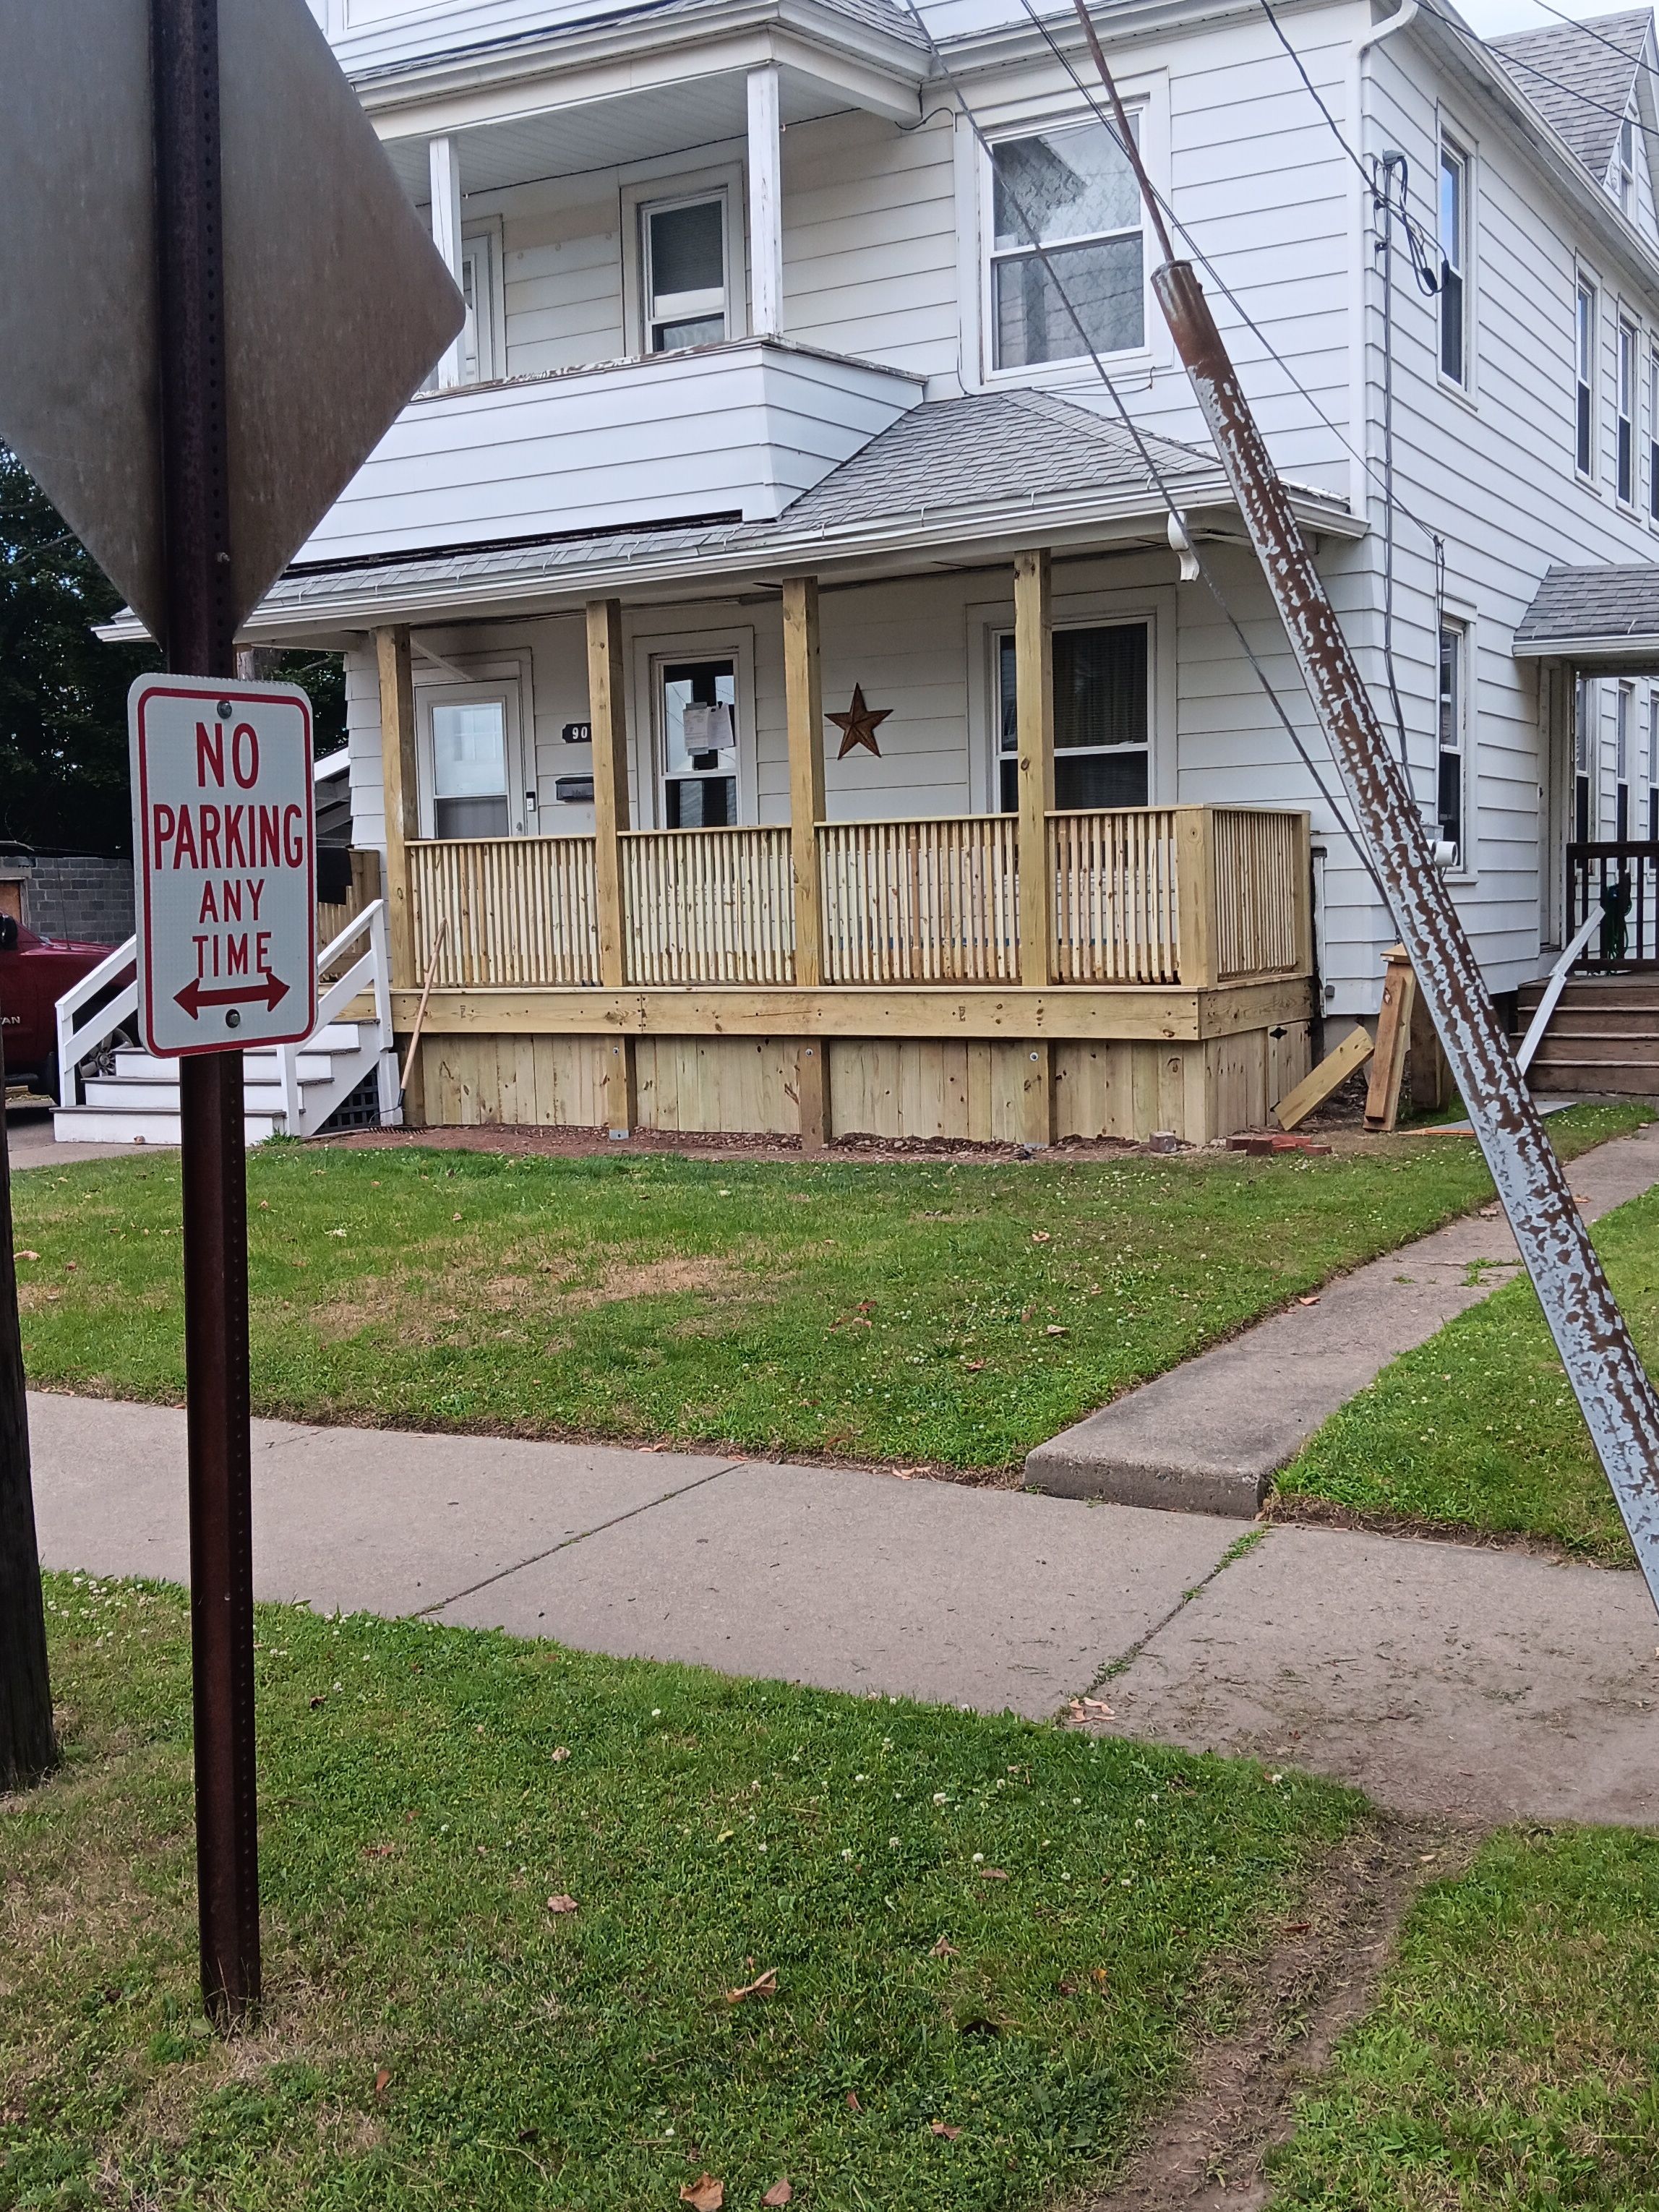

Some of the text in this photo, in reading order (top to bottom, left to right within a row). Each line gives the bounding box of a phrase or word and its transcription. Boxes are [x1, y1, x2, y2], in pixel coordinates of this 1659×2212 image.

[195, 722, 260, 789] NO
[572, 726, 588, 740] 90
[153, 803, 304, 870] PARKING
[199, 878, 265, 924] ANY
[192, 931, 273, 978] TIME
[0, 1016, 20, 1025] AN
